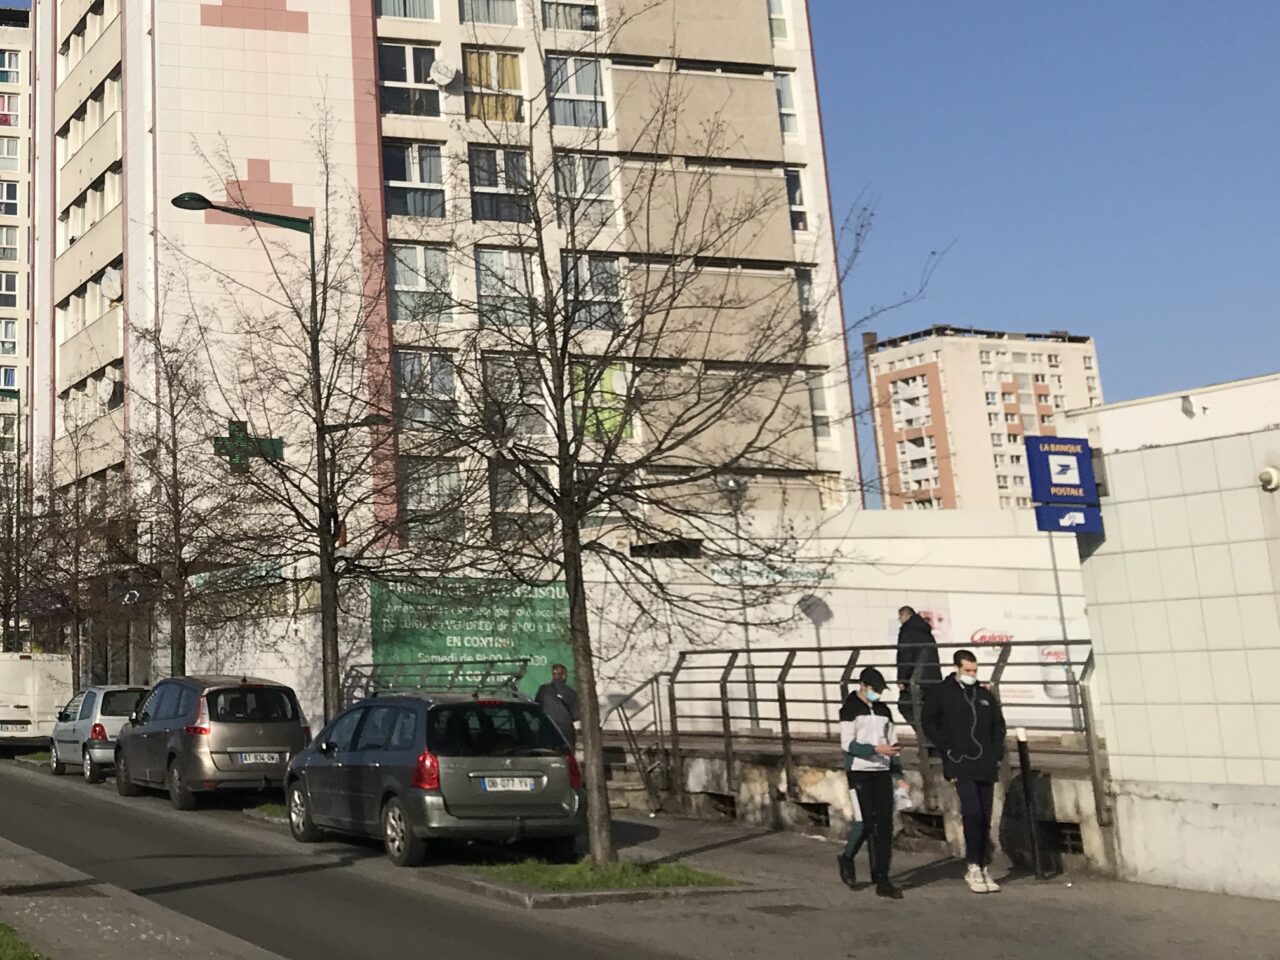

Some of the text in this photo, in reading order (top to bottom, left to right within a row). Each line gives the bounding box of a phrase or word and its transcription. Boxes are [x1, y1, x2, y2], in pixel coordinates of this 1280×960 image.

[1051, 486, 1085, 497] POSTALE
[446, 636, 461, 647] EN
[417, 652, 457, 664] Samedi
